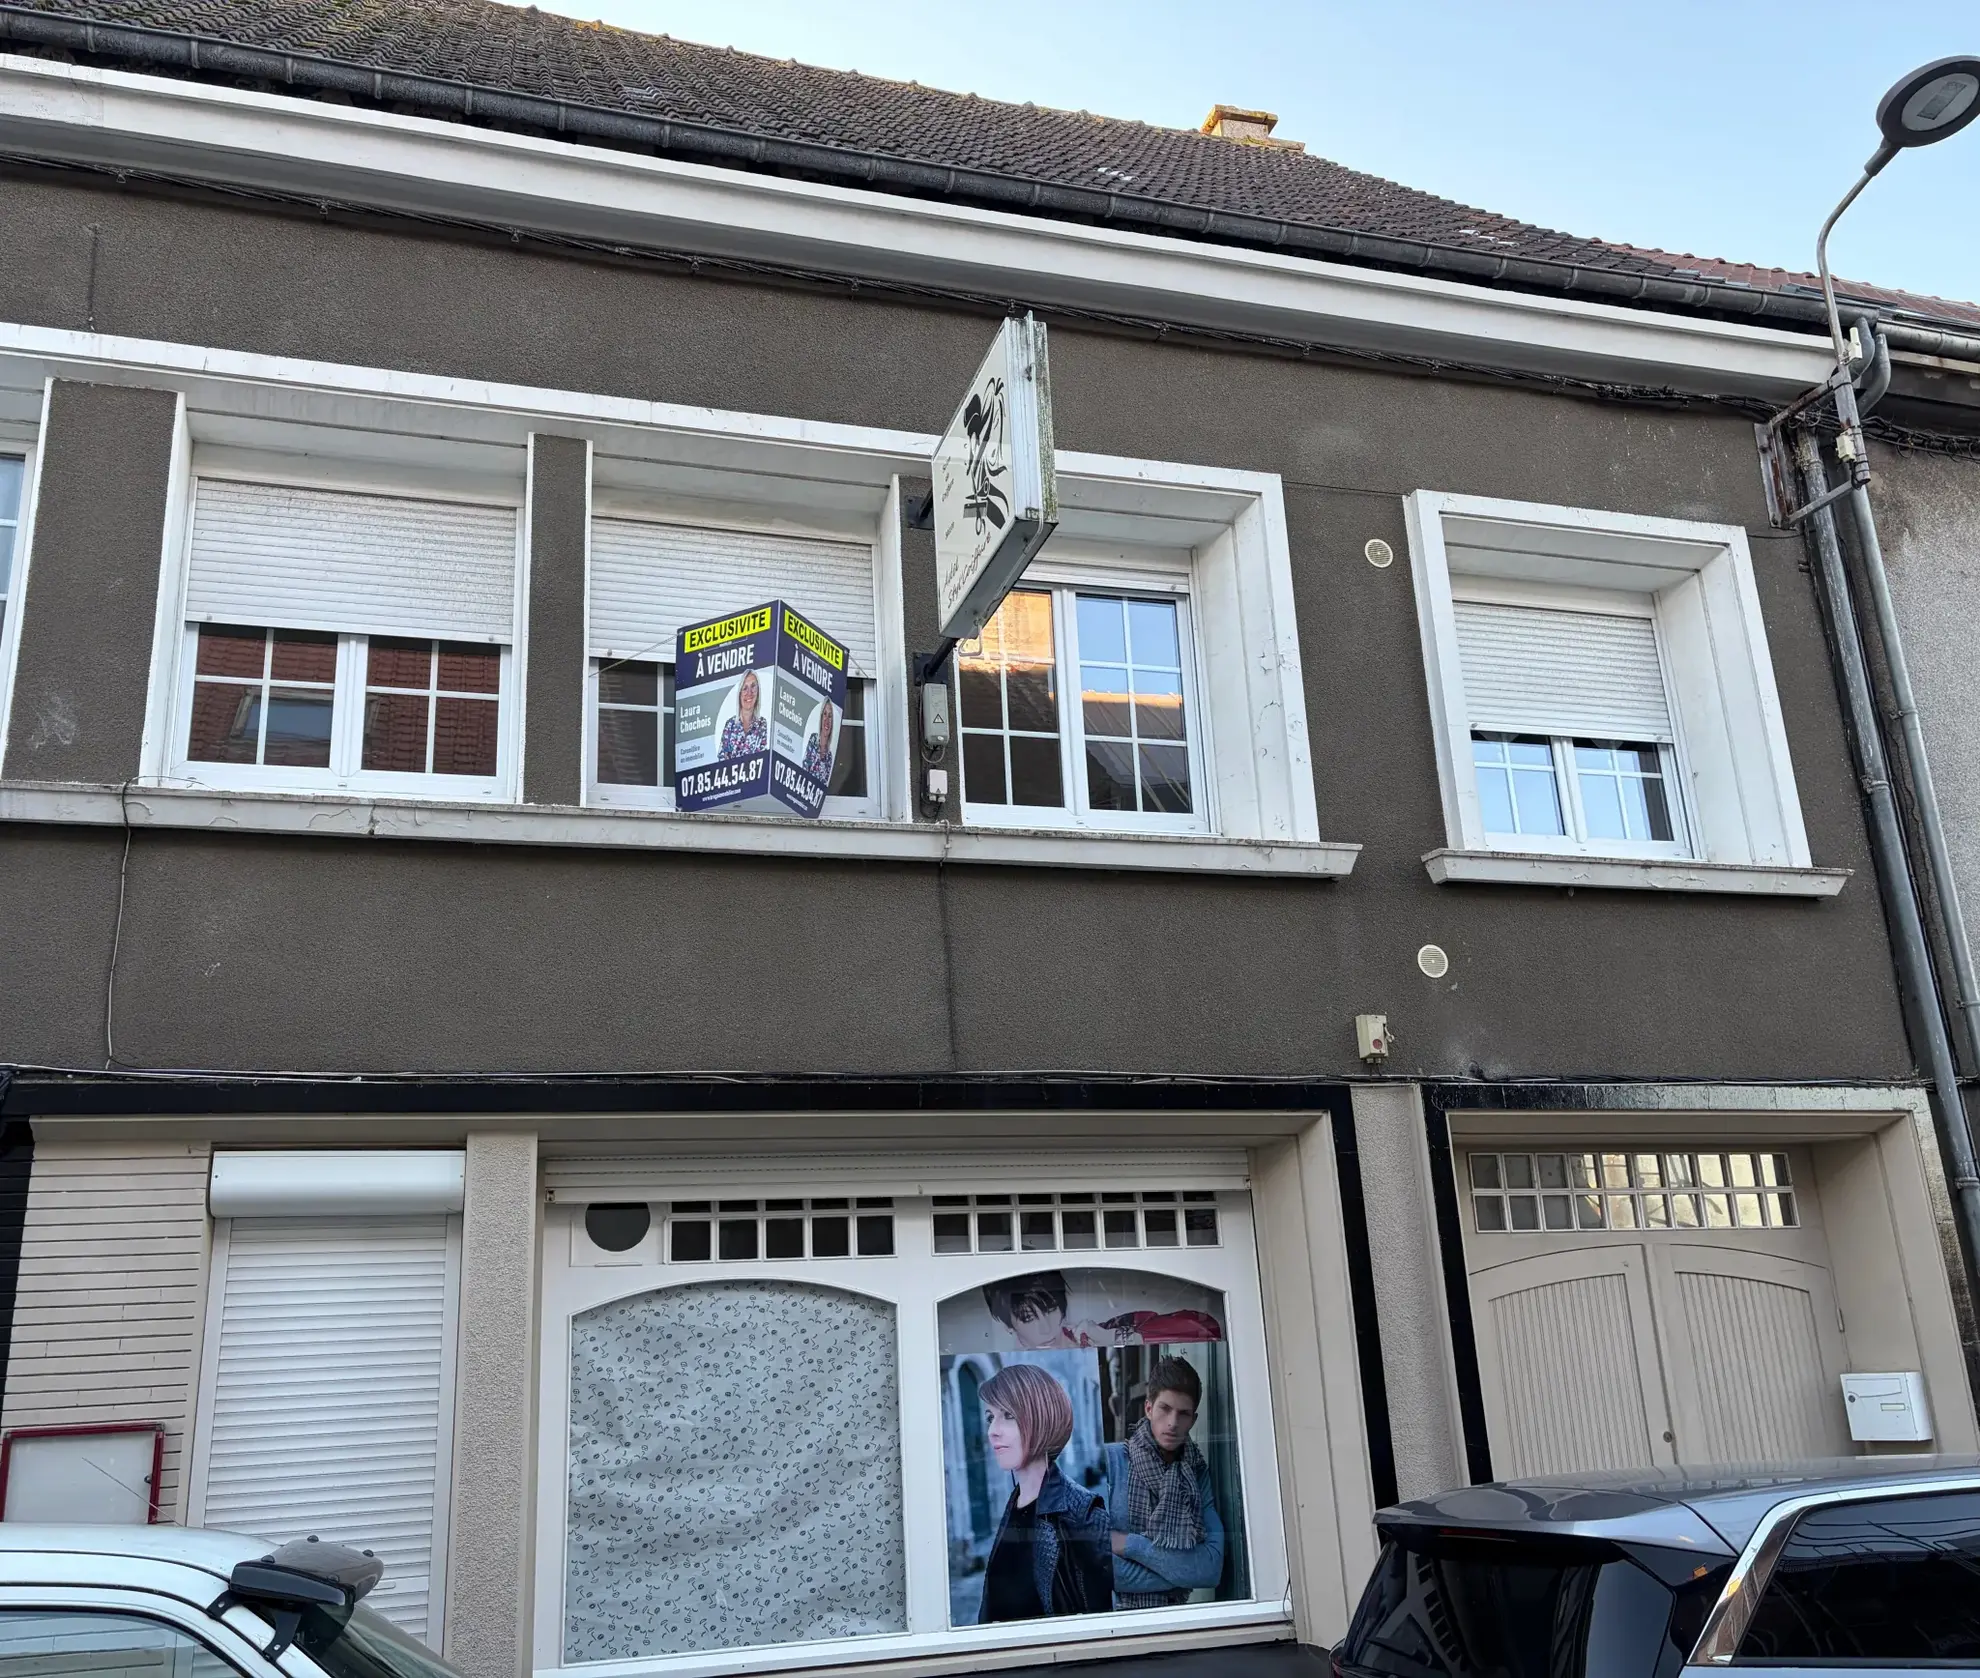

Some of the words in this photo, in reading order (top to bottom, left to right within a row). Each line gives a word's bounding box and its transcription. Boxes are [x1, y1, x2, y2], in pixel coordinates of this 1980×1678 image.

[689, 611, 766, 648] EXCLUSIVITE
[788, 614, 840, 665] EXCLUSIVITE
[695, 652, 704, 679] À
[707, 643, 755, 675] VENDRE
[792, 643, 800, 671] À
[801, 653, 833, 693] VENDRE
[680, 704, 700, 719] Laura
[779, 686, 796, 706] Laura
[779, 701, 803, 726] Chochois
[680, 715, 711, 733] Chochois
[681, 758, 764, 797] 07.85.44.54.87
[774, 760, 824, 809] 07.85.44.54.87
